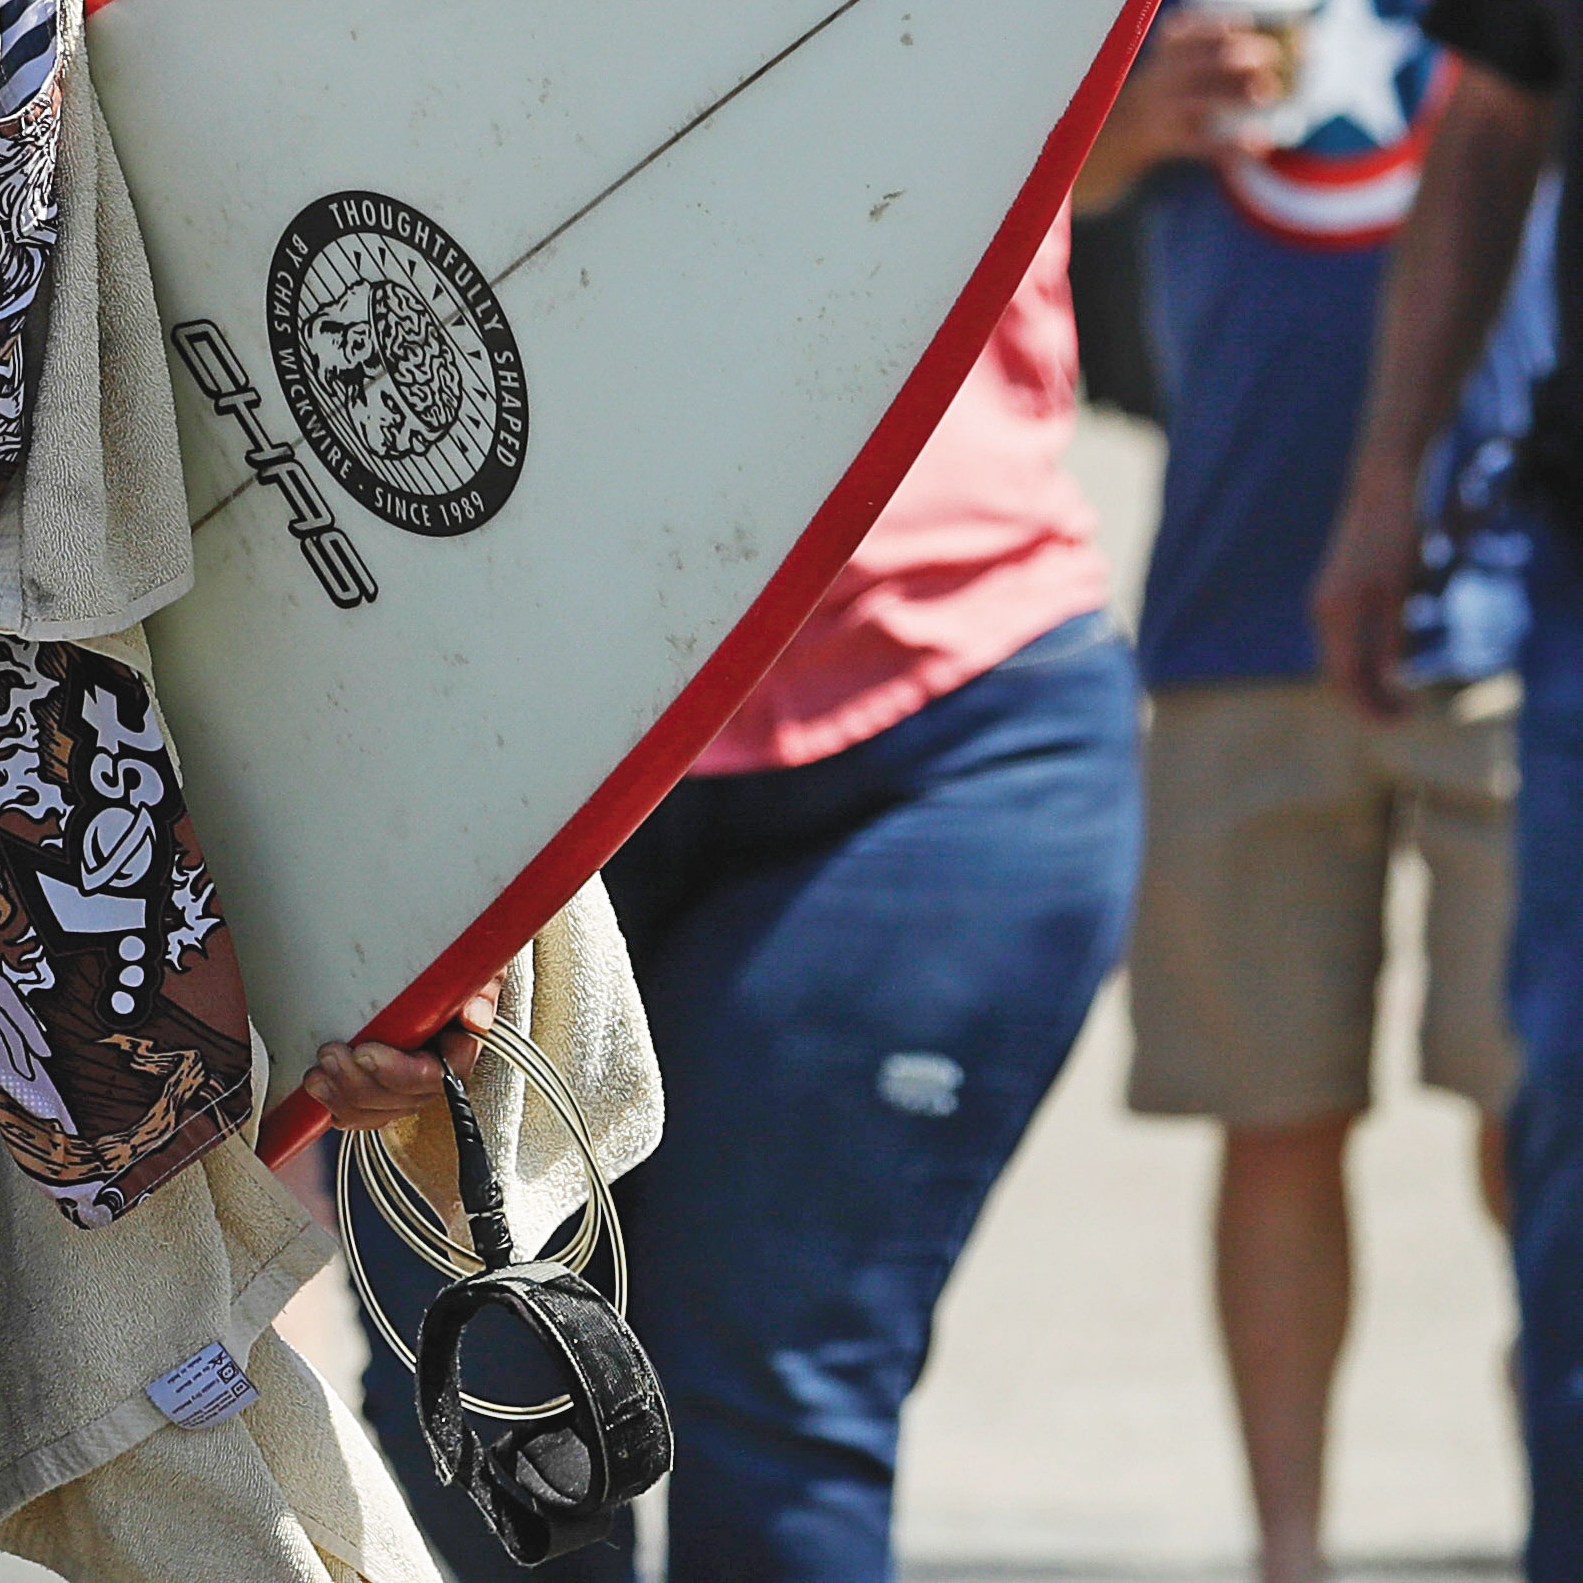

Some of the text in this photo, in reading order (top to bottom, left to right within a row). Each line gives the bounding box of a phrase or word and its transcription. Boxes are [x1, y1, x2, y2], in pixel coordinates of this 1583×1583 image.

[274, 233, 353, 479] BY CHAS WICKWIRE
[328, 199, 523, 468] THOUGHTFULLY SHAPED
[374, 486, 485, 527] SINCE 1989
